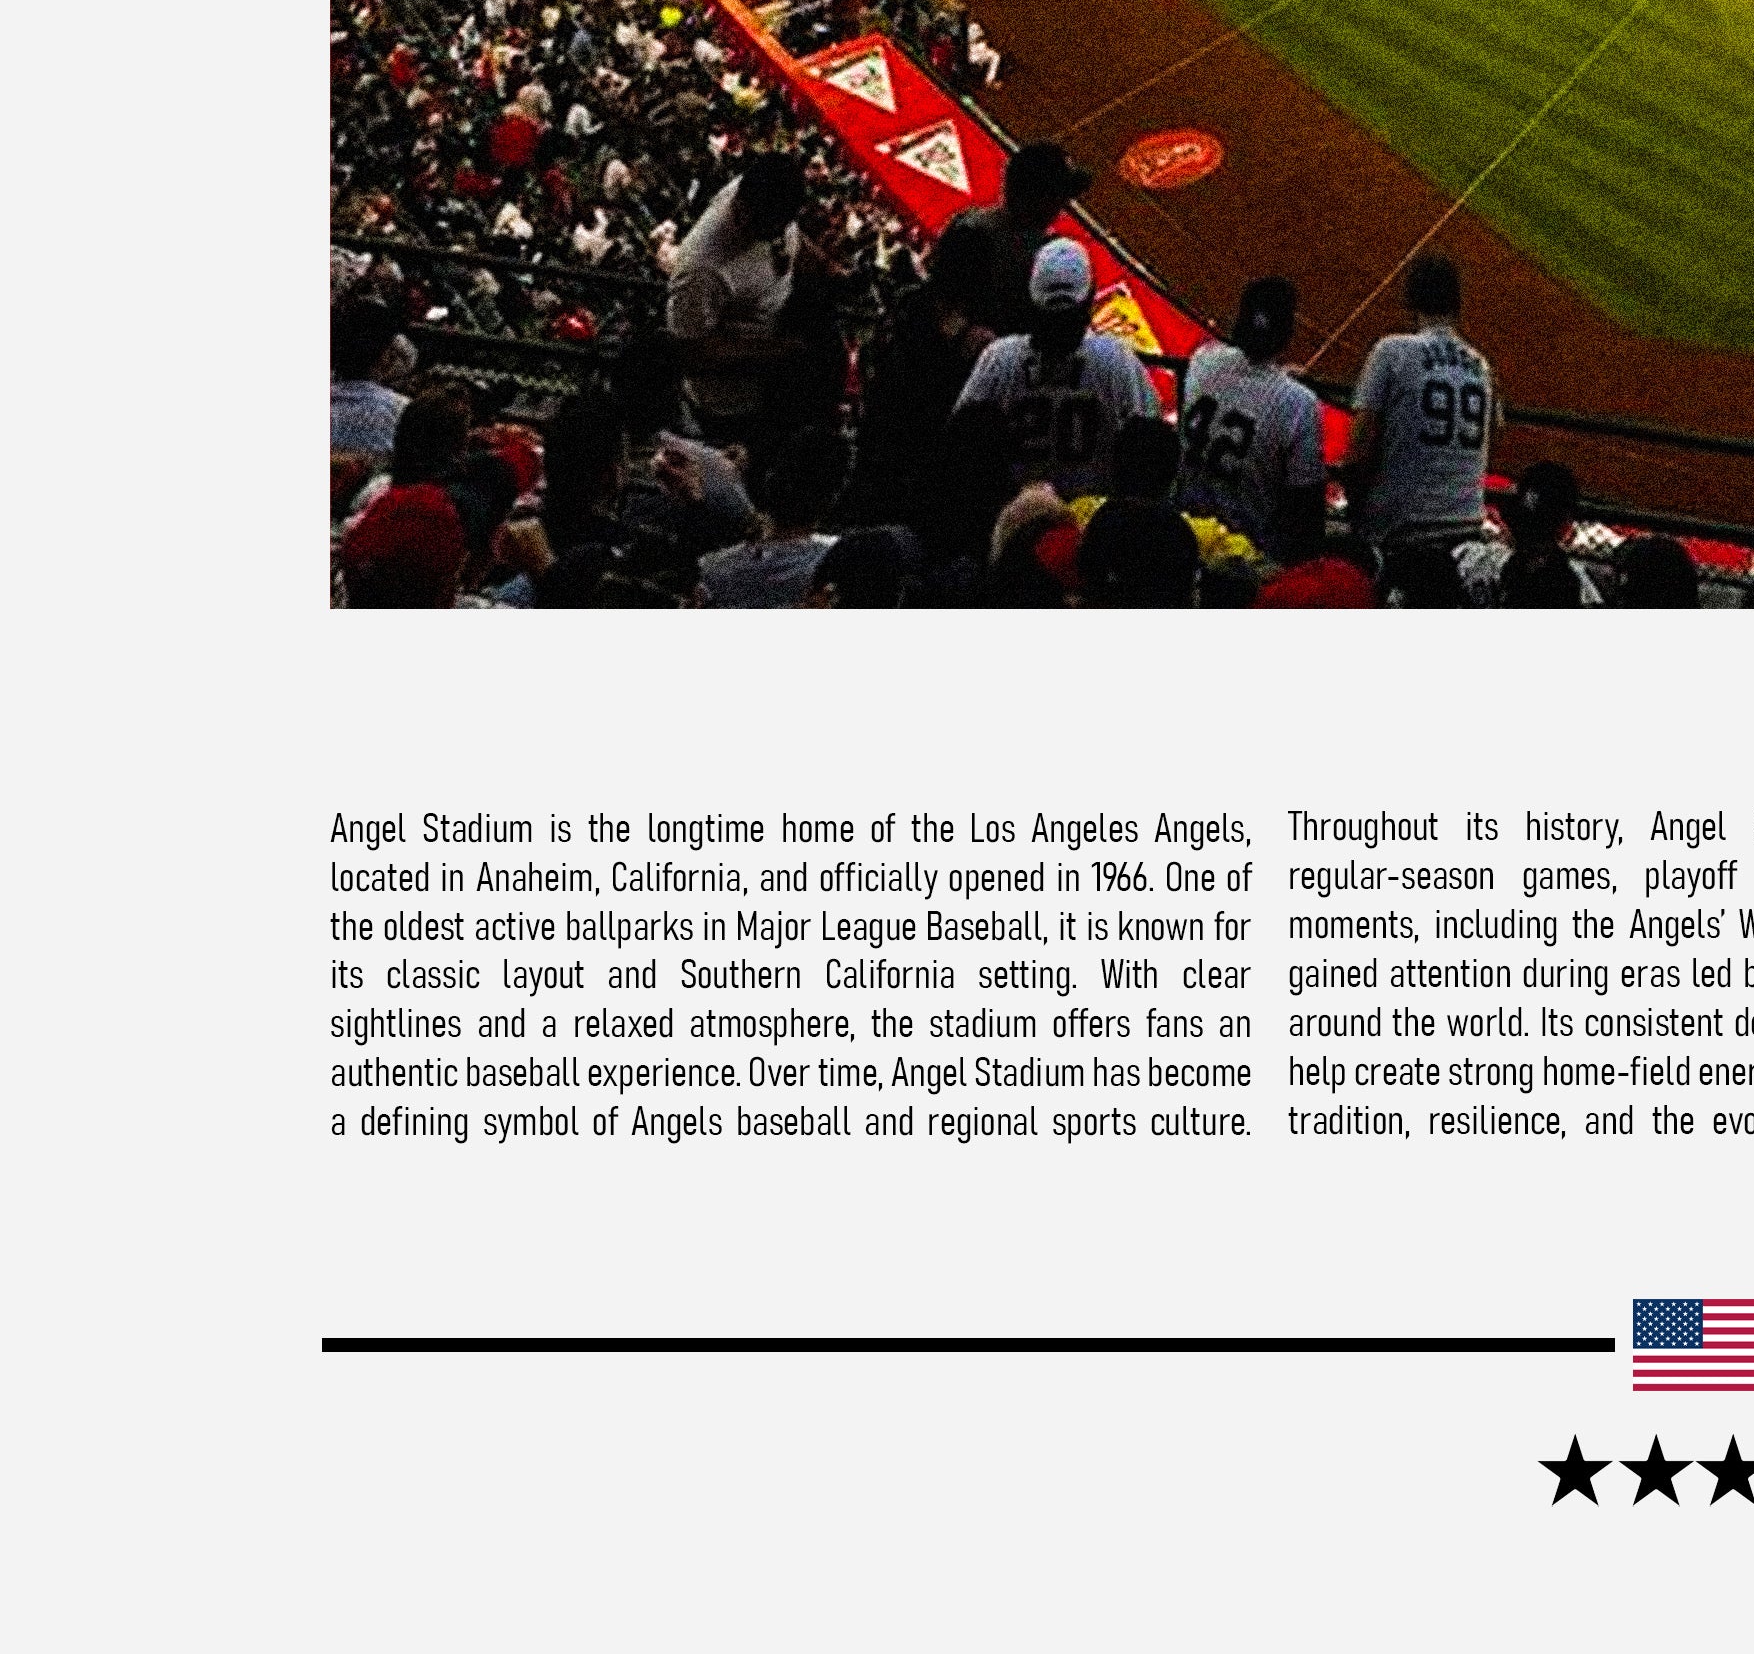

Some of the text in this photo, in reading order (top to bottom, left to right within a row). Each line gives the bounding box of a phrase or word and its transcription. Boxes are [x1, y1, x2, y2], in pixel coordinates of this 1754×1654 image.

[1420, 380, 1487, 450] 99
[1183, 395, 1257, 484] 42
[331, 813, 1250, 851] Angel Stadium is the longtime home of the Los Angeles Angels,
[1288, 811, 1438, 849] Throughout
[1467, 812, 1498, 840] its
[1527, 811, 1622, 849] history,
[1651, 811, 1726, 849] Angel
[332, 862, 1252, 900] located in Anaheim, California, and officially opened in 1966. One of
[1290, 860, 1493, 898] regular-season
[1524, 868, 1616, 898] games,
[1646, 860, 1737, 898] playoff
[330, 911, 1251, 949] the oldest active ballparks in Major League Baseball, it is known for
[332, 959, 1251, 997] its classic layout and Southern California setting. With clear
[331, 1008, 1250, 1046] sightlines and a relaxed atmosphere, the stadium offers fans an
[332, 1057, 1250, 1095] authentic baseball experience. Over time, Angel Stadium has become
[332, 1106, 1250, 1144] a defining symbol of Angels baseball and regional sports culture.
